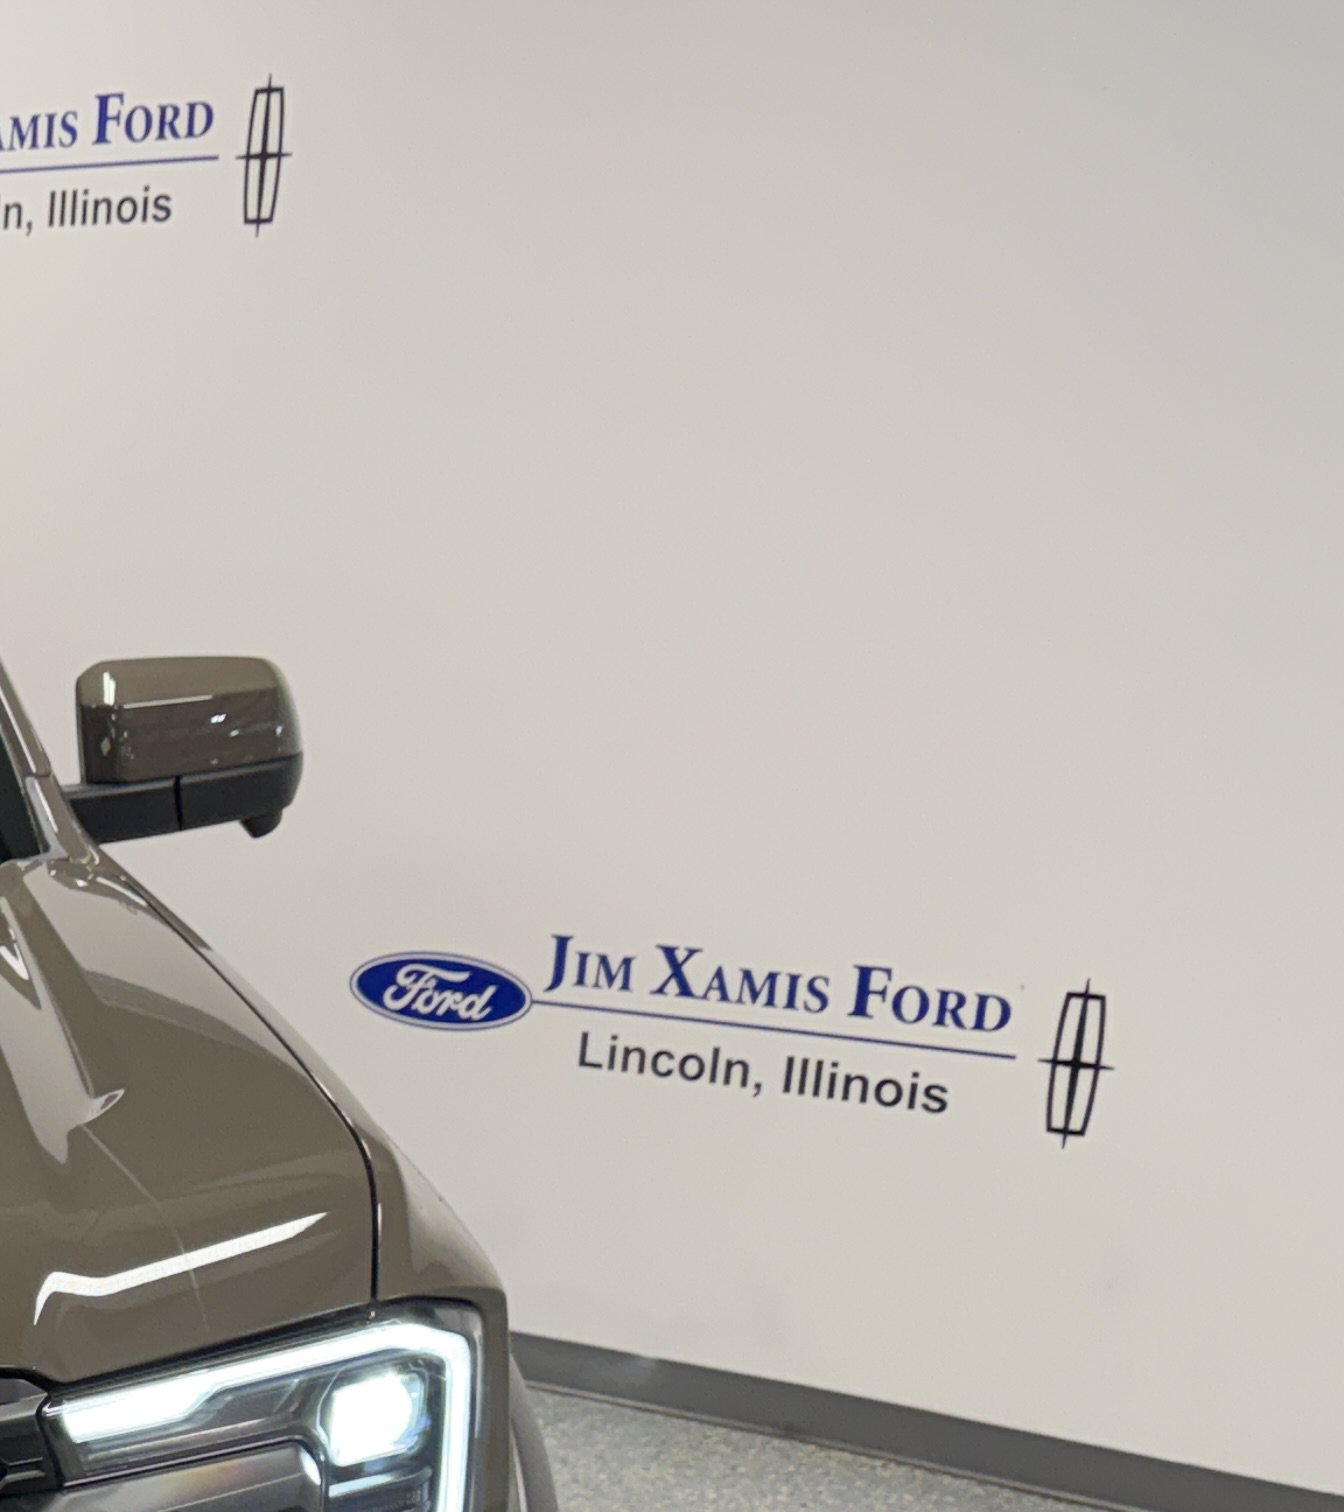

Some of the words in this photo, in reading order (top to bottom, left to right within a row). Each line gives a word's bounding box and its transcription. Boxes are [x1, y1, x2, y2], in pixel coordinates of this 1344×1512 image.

[48, 186, 173, 227] Illinois
[383, 961, 498, 1023] Ford
[578, 1030, 764, 1097] Lincoln,
[782, 1056, 950, 1116] Illinois
